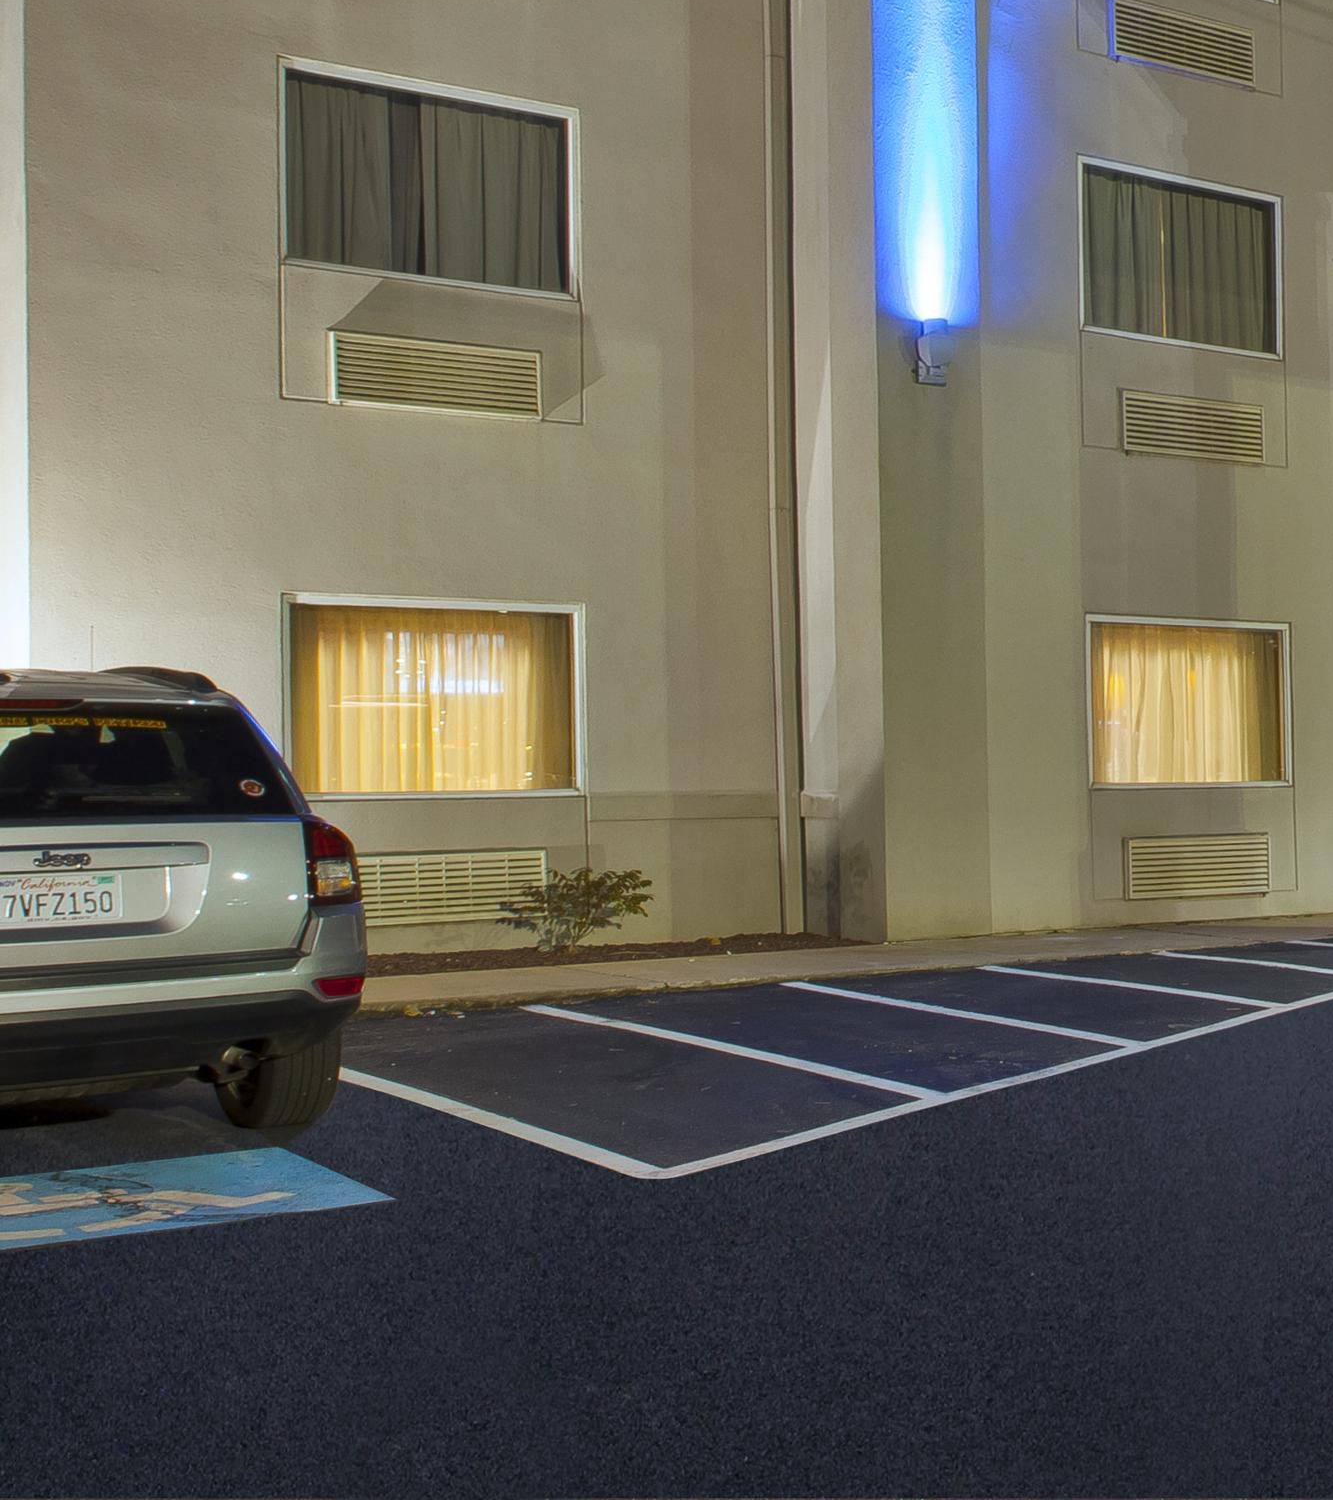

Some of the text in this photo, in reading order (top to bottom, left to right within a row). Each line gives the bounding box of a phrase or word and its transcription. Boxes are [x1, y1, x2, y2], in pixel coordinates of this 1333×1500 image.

[33, 851, 91, 869] Jeep
[20, 878, 97, 891] California
[2, 891, 113, 918] 7VFZ150
